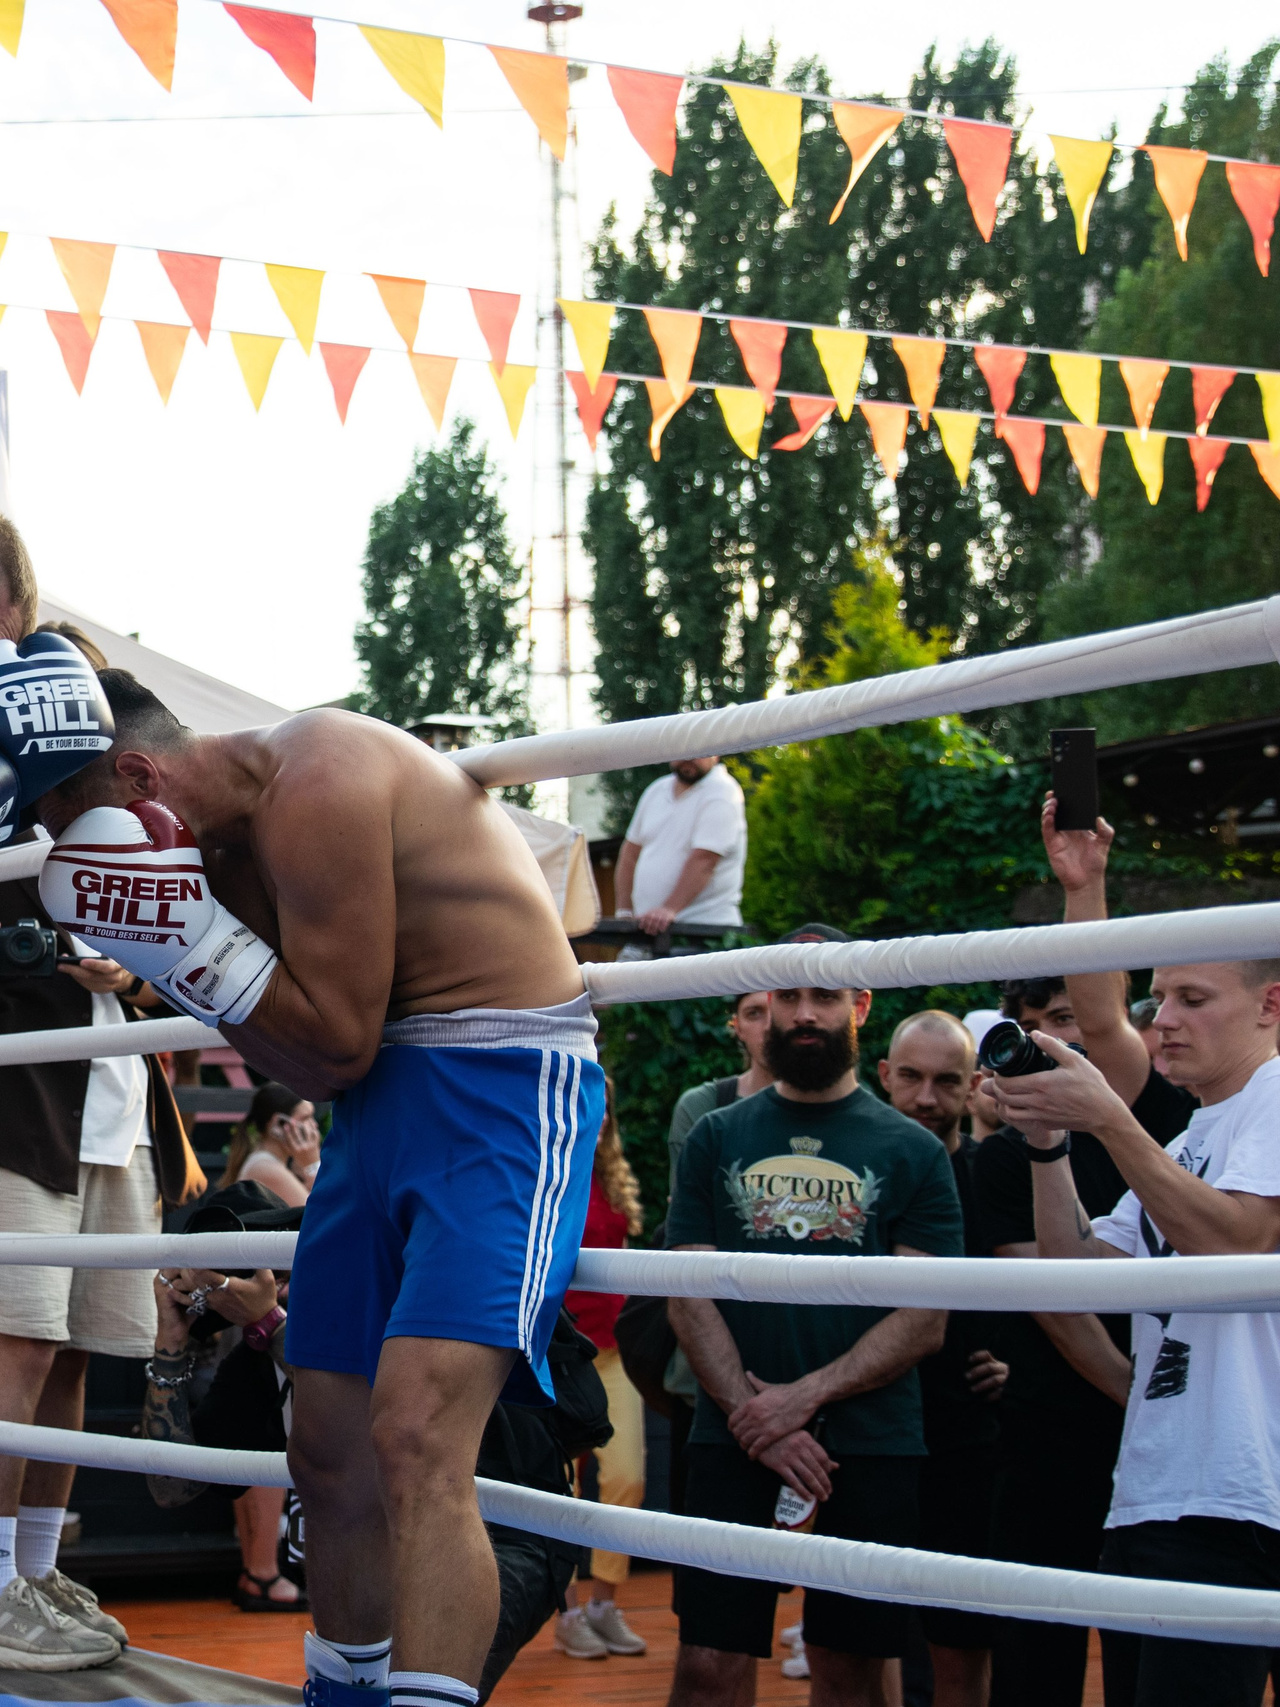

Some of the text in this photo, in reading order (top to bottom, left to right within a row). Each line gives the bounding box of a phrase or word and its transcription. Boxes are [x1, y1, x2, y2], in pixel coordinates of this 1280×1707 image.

[5, 700, 99, 735] HILL
[46, 738, 100, 749] BE YOUR BEST SELF
[72, 869, 204, 901] GREEN
[76, 892, 186, 929] HILL
[84, 926, 160, 942] BE YOUR BEST SELF
[739, 1173, 863, 1206] VICTORY
